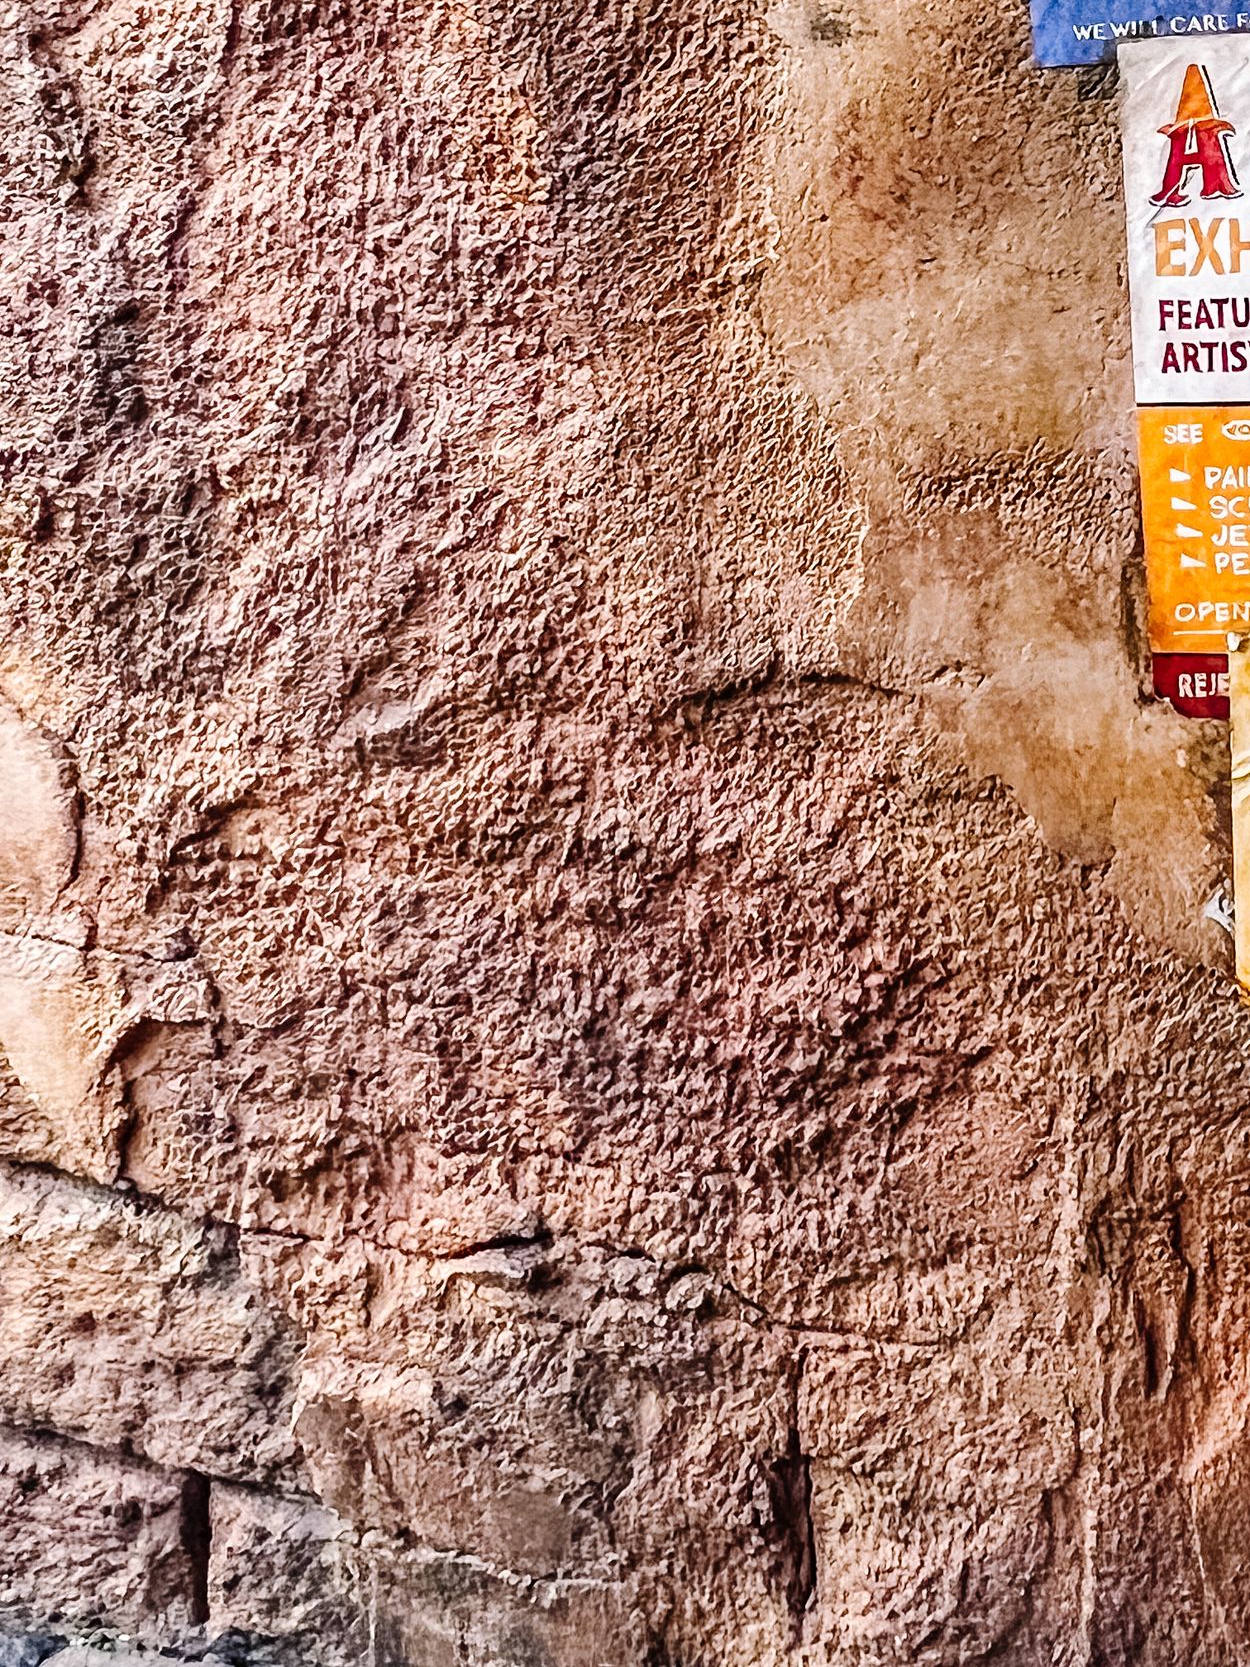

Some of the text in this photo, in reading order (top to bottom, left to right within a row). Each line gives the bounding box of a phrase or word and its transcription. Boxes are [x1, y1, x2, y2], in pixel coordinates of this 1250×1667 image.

[1072, 24, 1106, 41] WE
[1170, 14, 1230, 34] CARE
[1163, 423, 1203, 444] SEE
